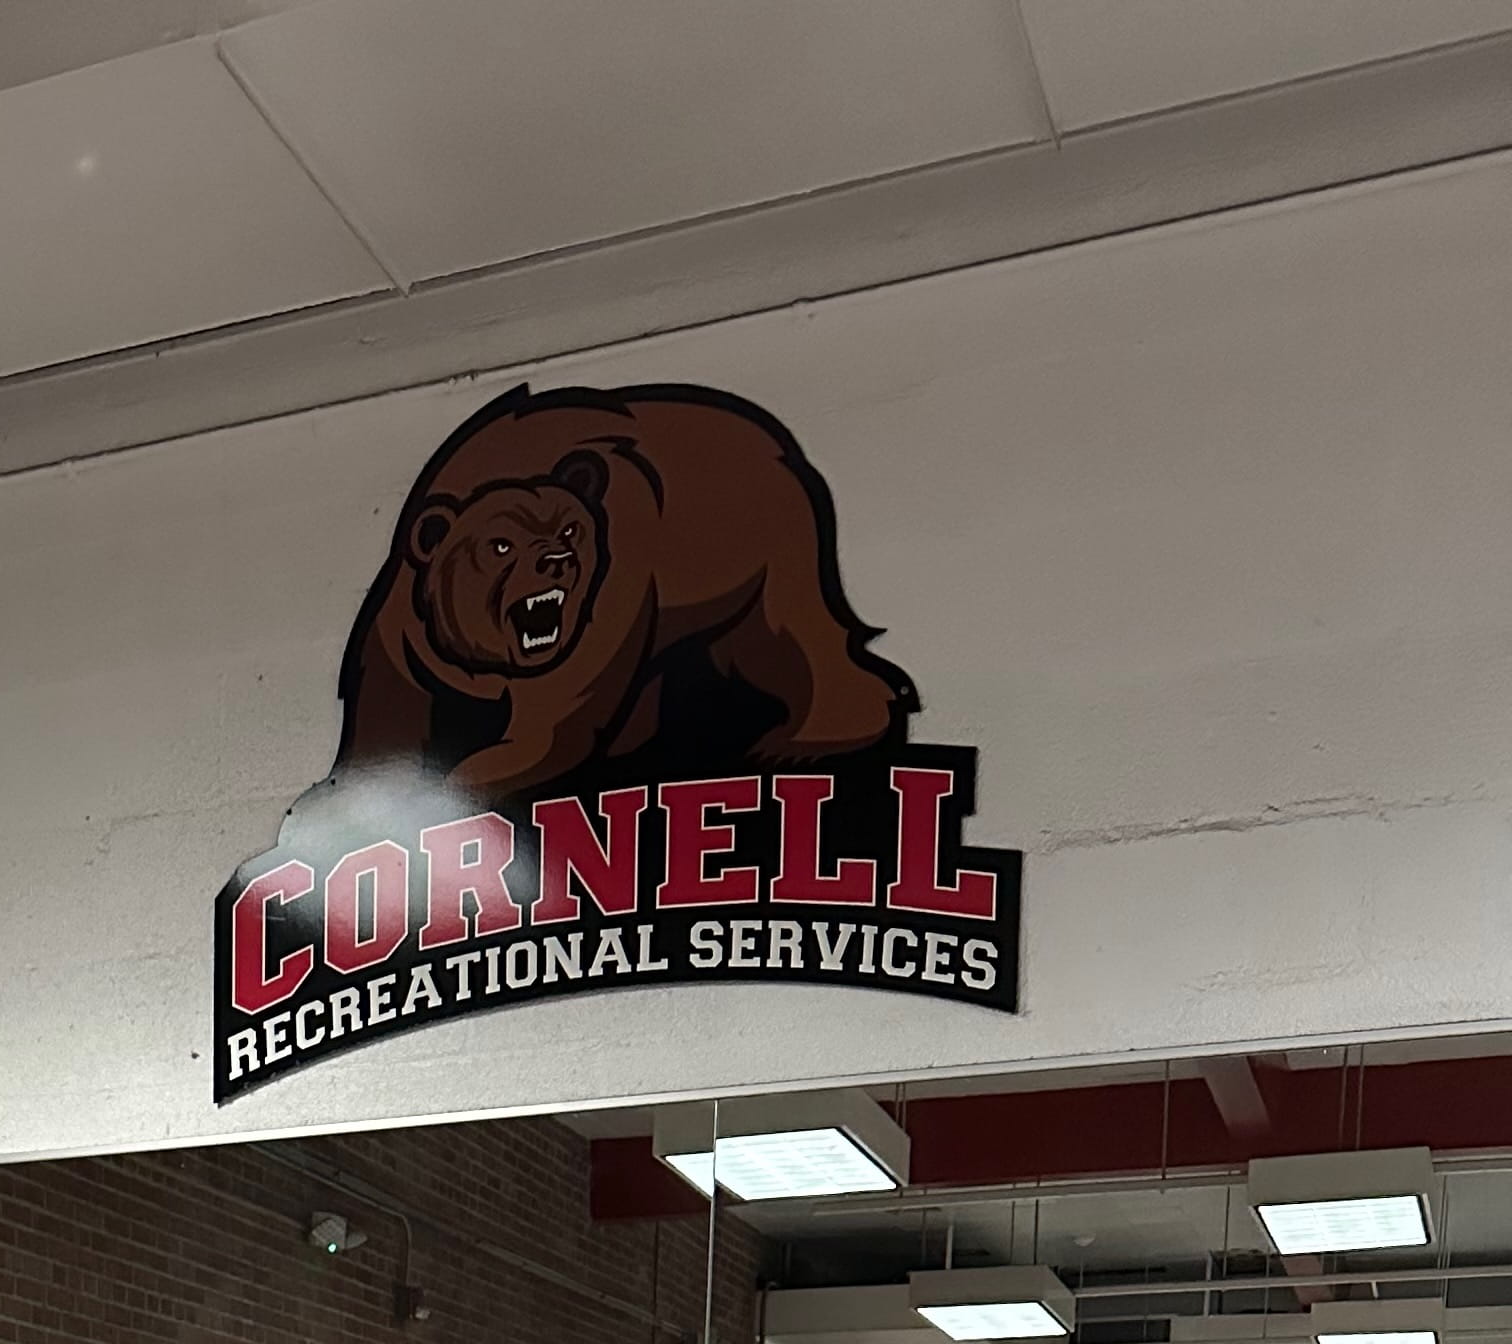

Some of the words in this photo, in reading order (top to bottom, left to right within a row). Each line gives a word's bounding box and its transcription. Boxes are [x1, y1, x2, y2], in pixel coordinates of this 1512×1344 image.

[232, 767, 997, 1015] CORNELL
[227, 925, 670, 1081] RECREATIONAL
[689, 919, 998, 990] SERVICES
